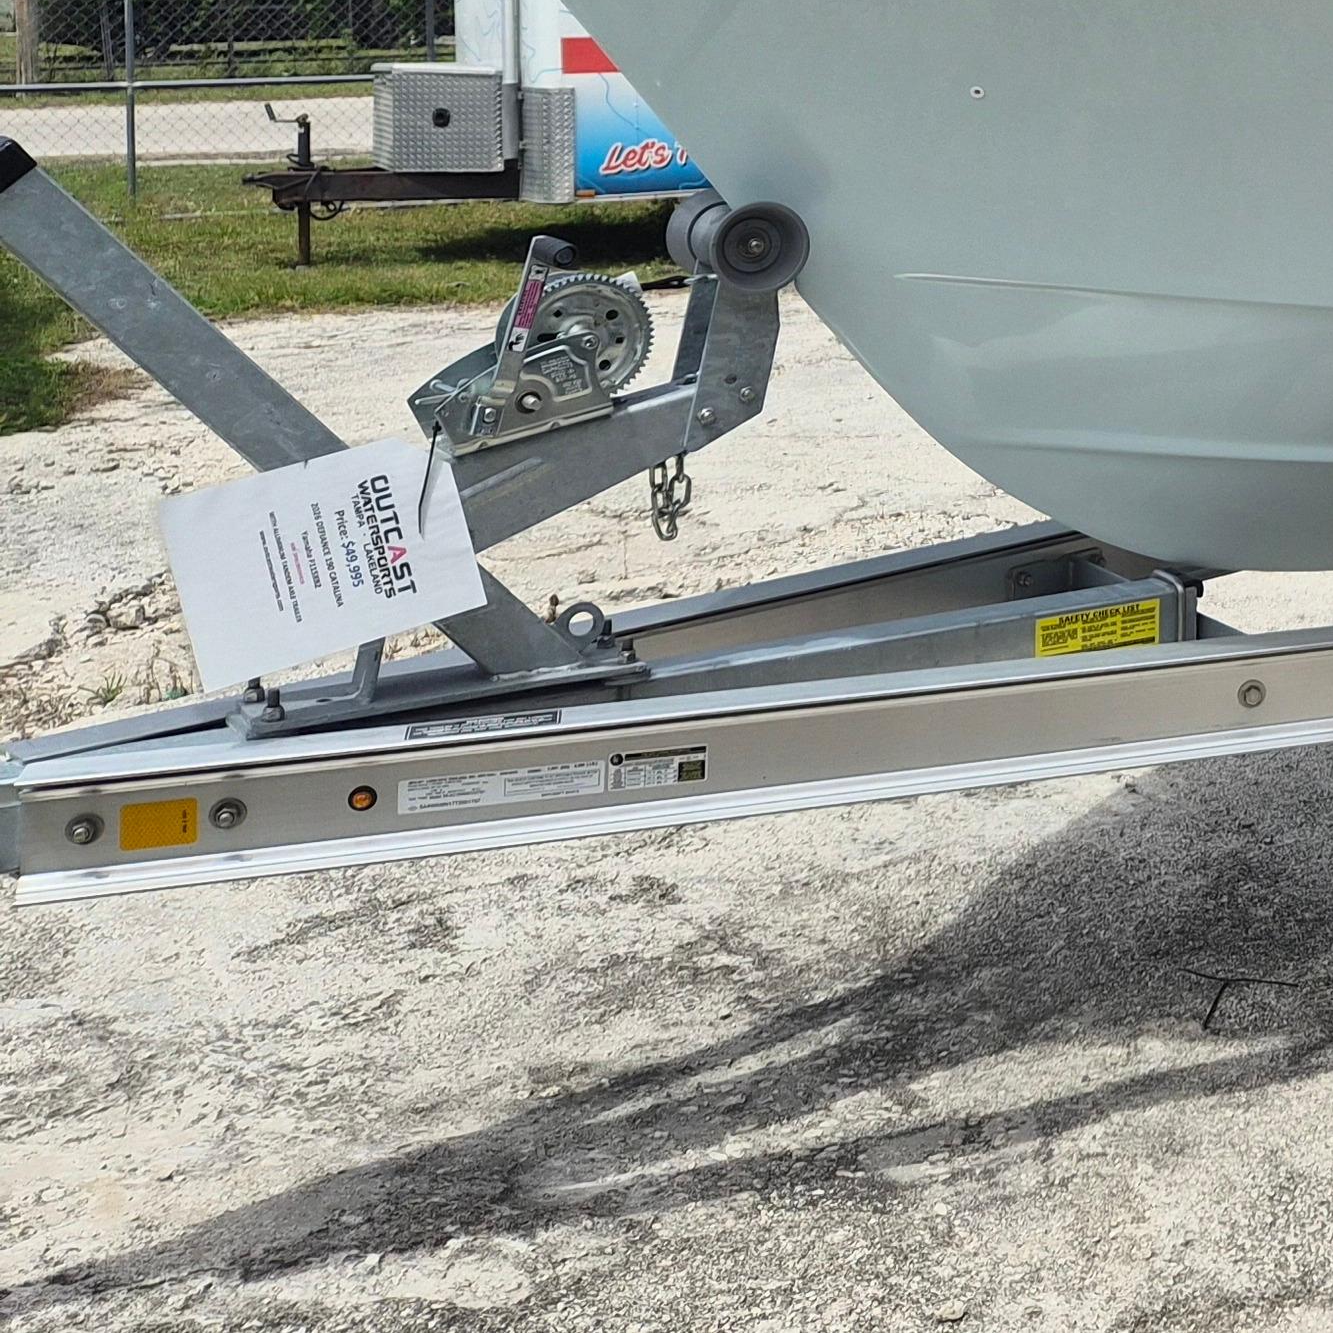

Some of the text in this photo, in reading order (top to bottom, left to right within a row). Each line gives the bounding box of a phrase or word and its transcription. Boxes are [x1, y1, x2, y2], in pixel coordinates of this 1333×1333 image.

[600, 138, 672, 175] Let's
[302, 531, 312, 558] Yamaha
[316, 522, 331, 556] DEFIANCE
[329, 572, 343, 607] CATALINA
[335, 510, 364, 587] Price: $49,995
[352, 494, 382, 594] TAMPA LAKELAND
[358, 480, 396, 598] WATERSPORTS
[371, 475, 416, 593] OUTCAST
[1058, 603, 1140, 625] SAFETY CHECK LIST
